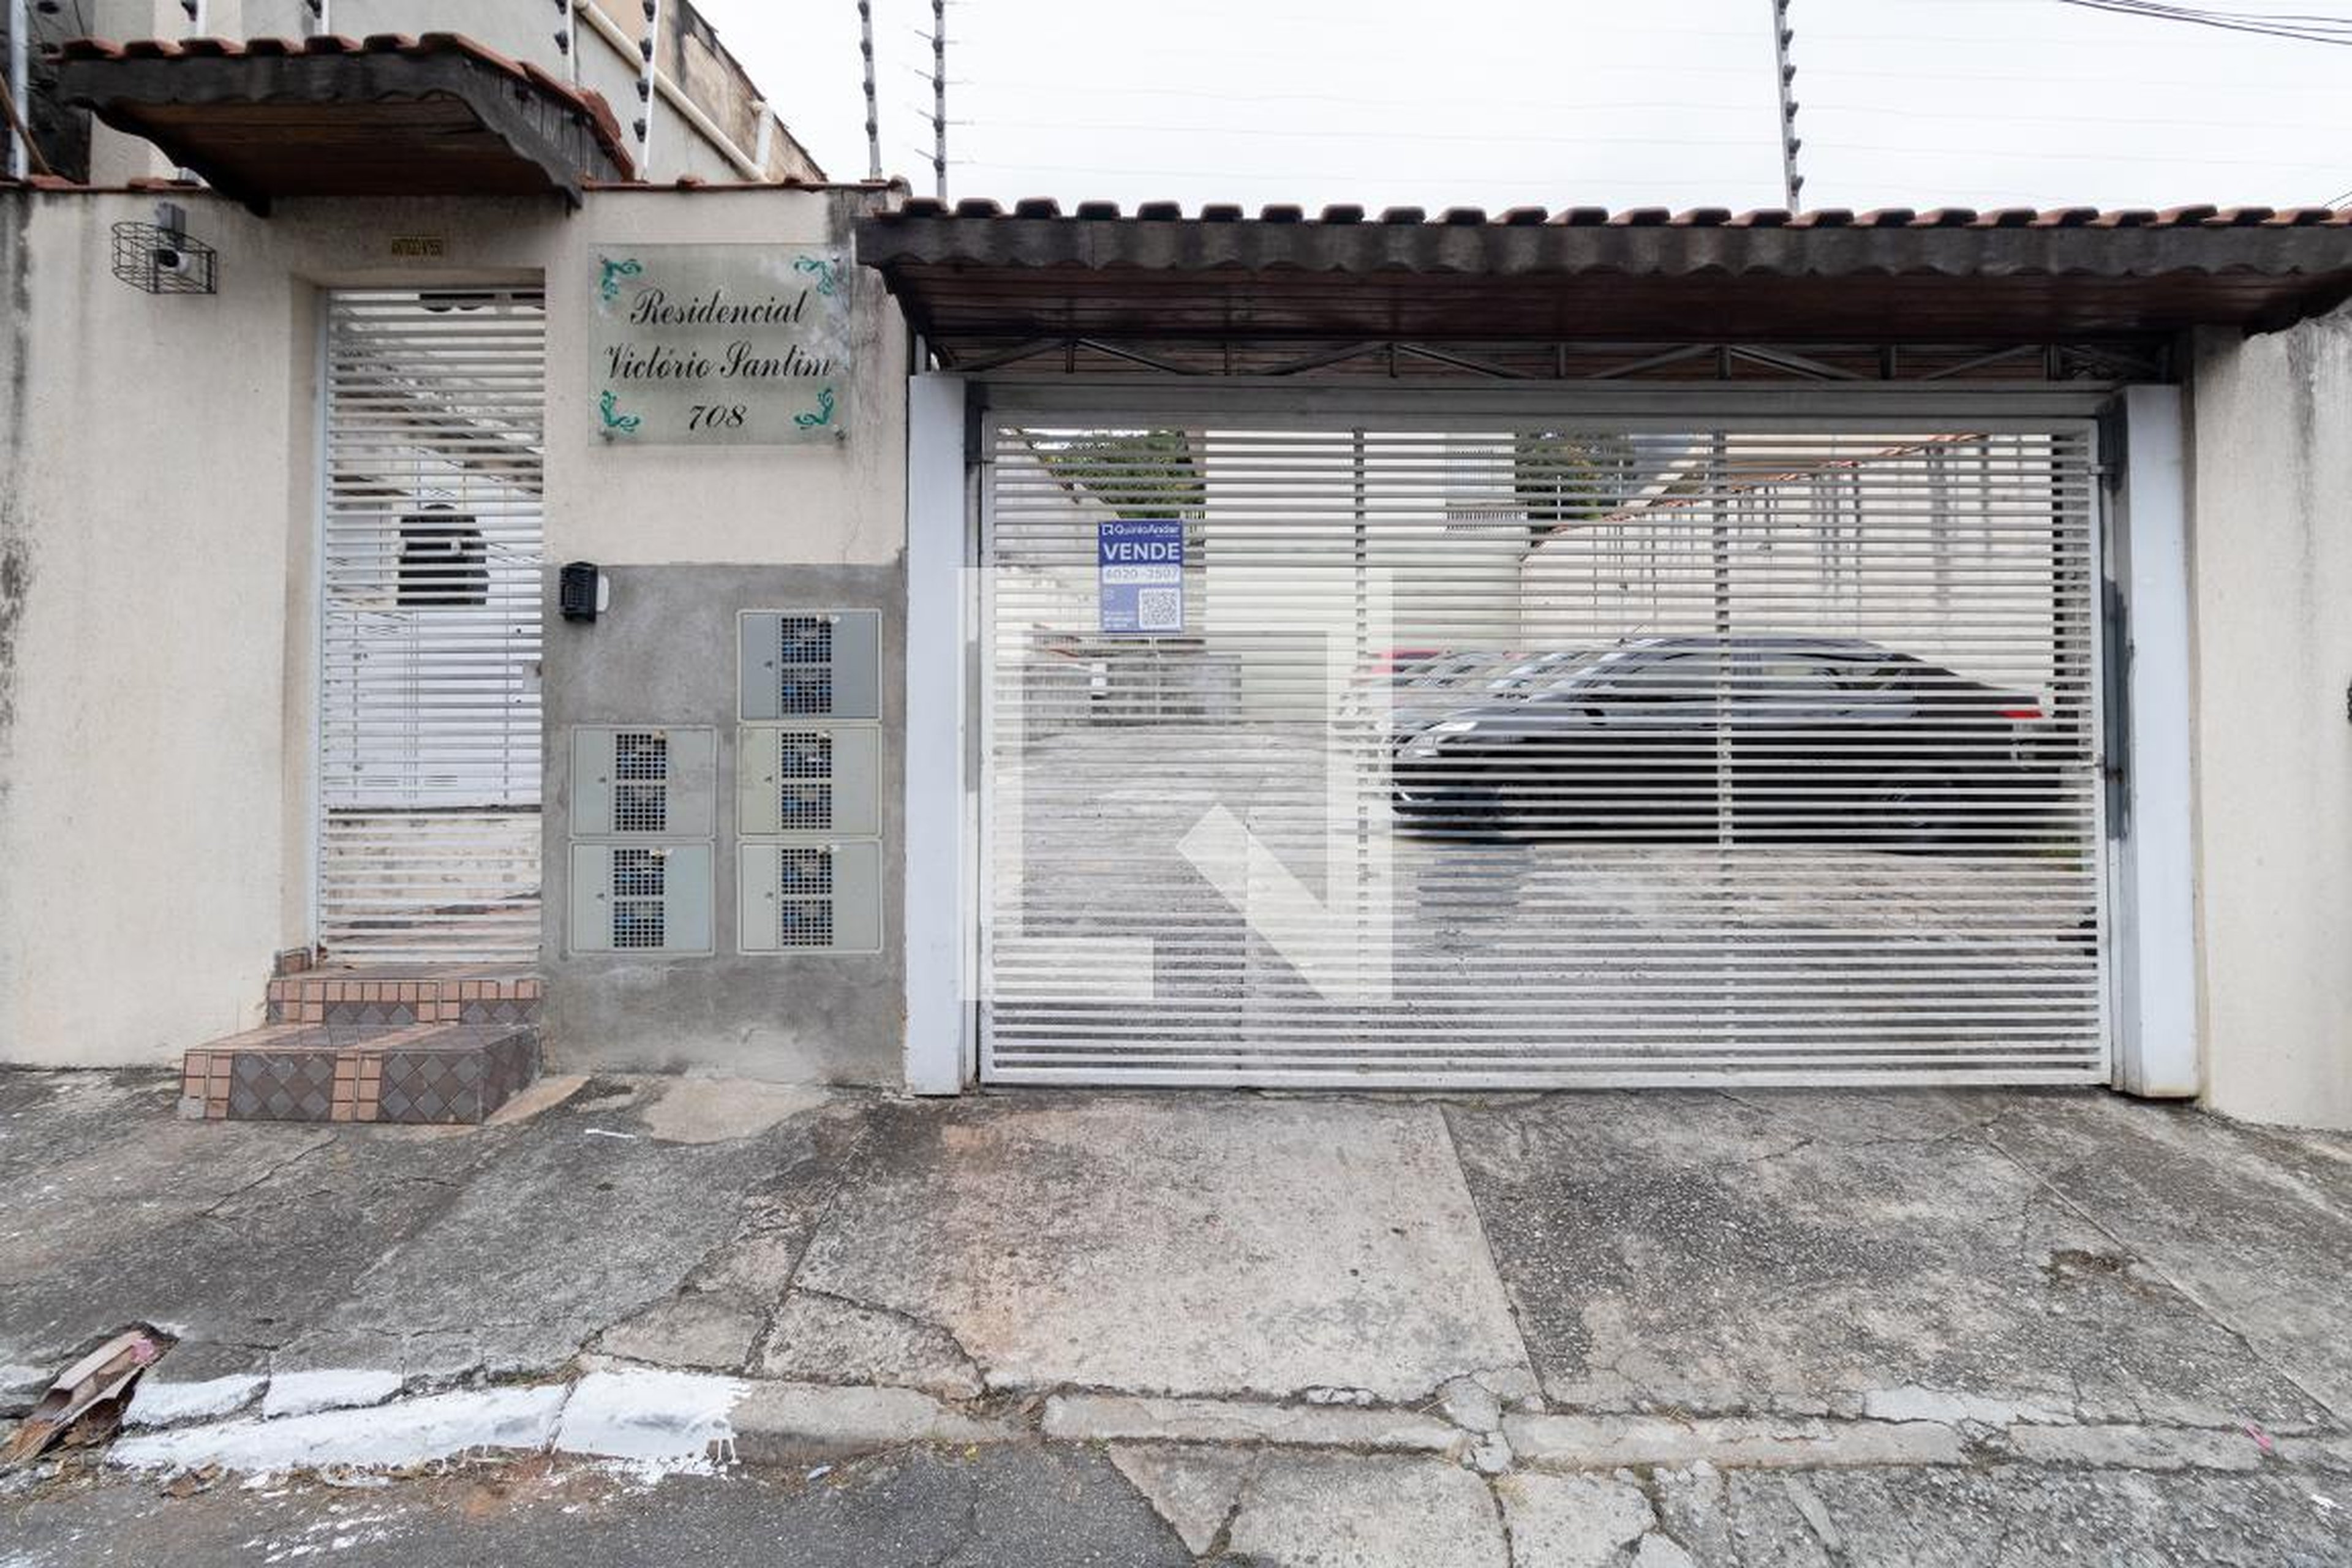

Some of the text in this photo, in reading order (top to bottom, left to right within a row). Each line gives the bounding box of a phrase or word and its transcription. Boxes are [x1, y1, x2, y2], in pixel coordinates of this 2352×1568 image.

[630, 288, 808, 325] Residencial
[689, 404, 748, 431] 708
[1103, 542, 1180, 561] VENDE
